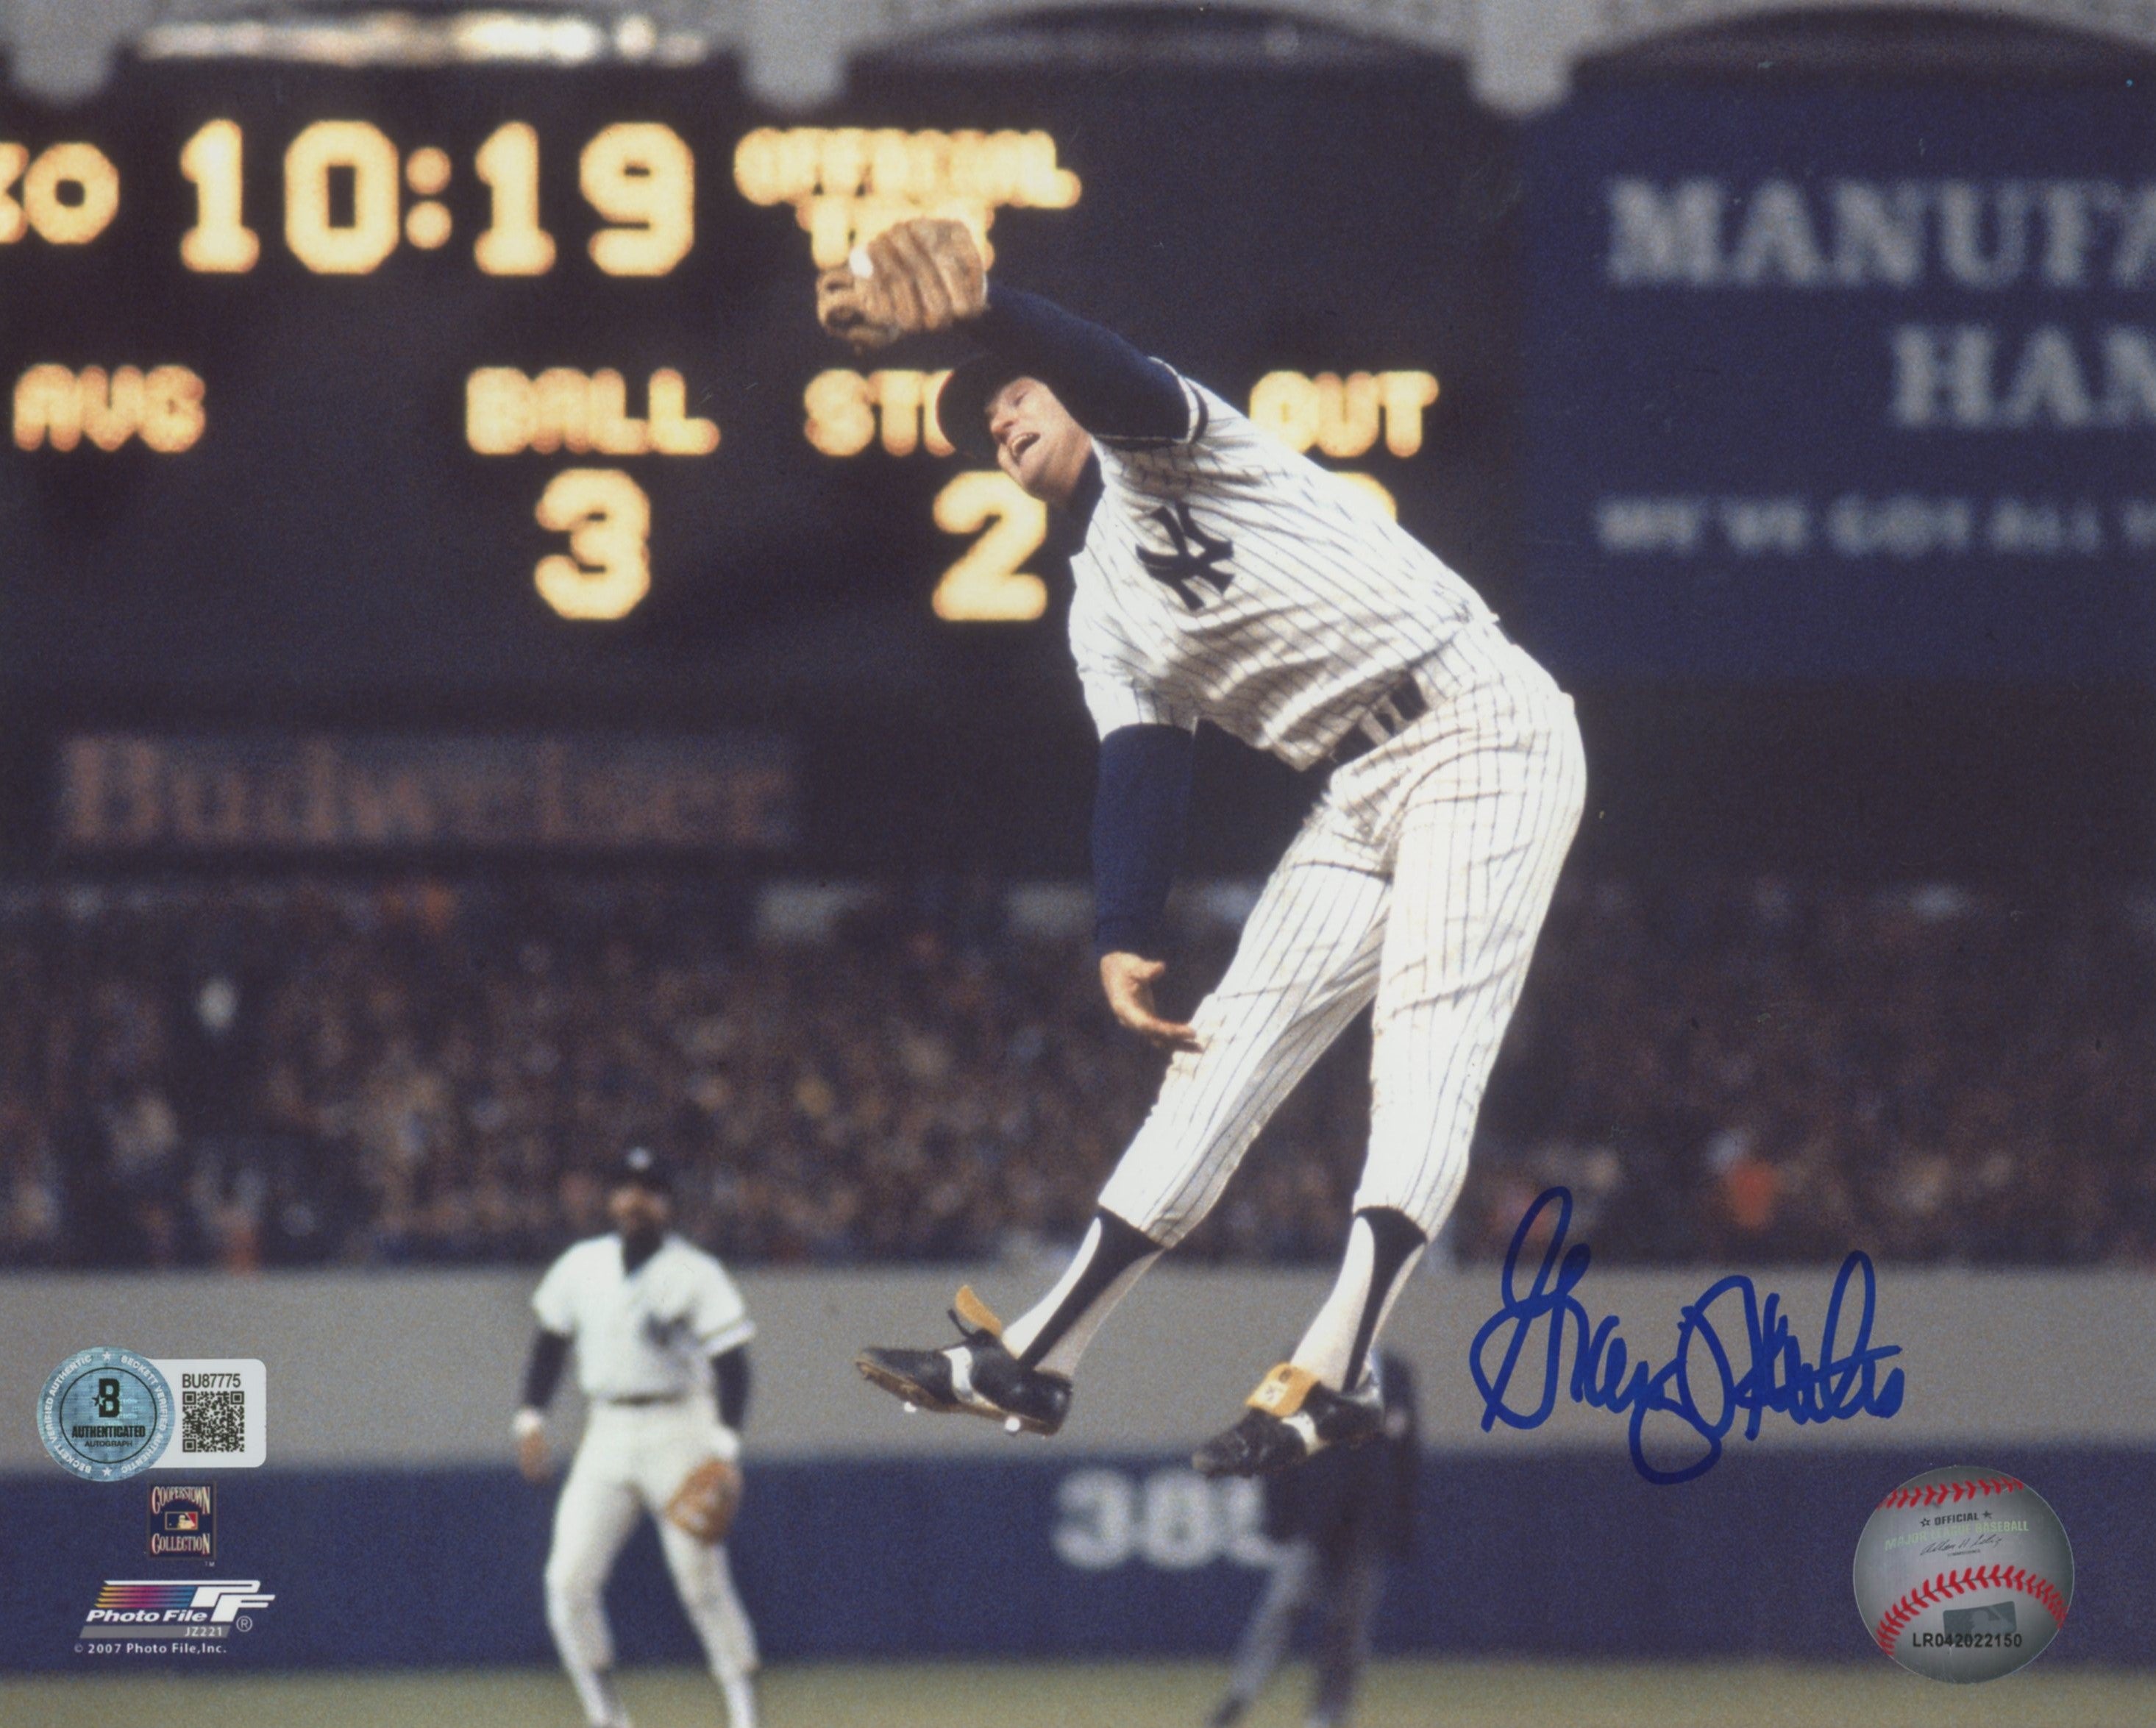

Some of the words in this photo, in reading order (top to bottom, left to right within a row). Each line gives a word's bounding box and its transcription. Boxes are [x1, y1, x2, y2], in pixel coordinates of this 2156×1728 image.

[179, 119, 694, 276] 10:19
[466, 366, 719, 454] BALL
[1250, 370, 1440, 458] OUT
[534, 469, 650, 619] 3
[932, 471, 1047, 621] 2
[49, 1355, 92, 1397] AUTHENTIC
[121, 1355, 159, 1384] BECKETT
[182, 1373, 241, 1388] BU87775
[43, 1398, 58, 1443] VERIFIED
[72, 1425, 146, 1437] AUTHENTICATED
[1884, 1532, 1927, 1551] MAJOR
[1975, 1521, 2029, 1534] BASEBALL
[1935, 1512, 1979, 1526] OFFICIAL
[1913, 1632, 2022, 1648] LR042022150
